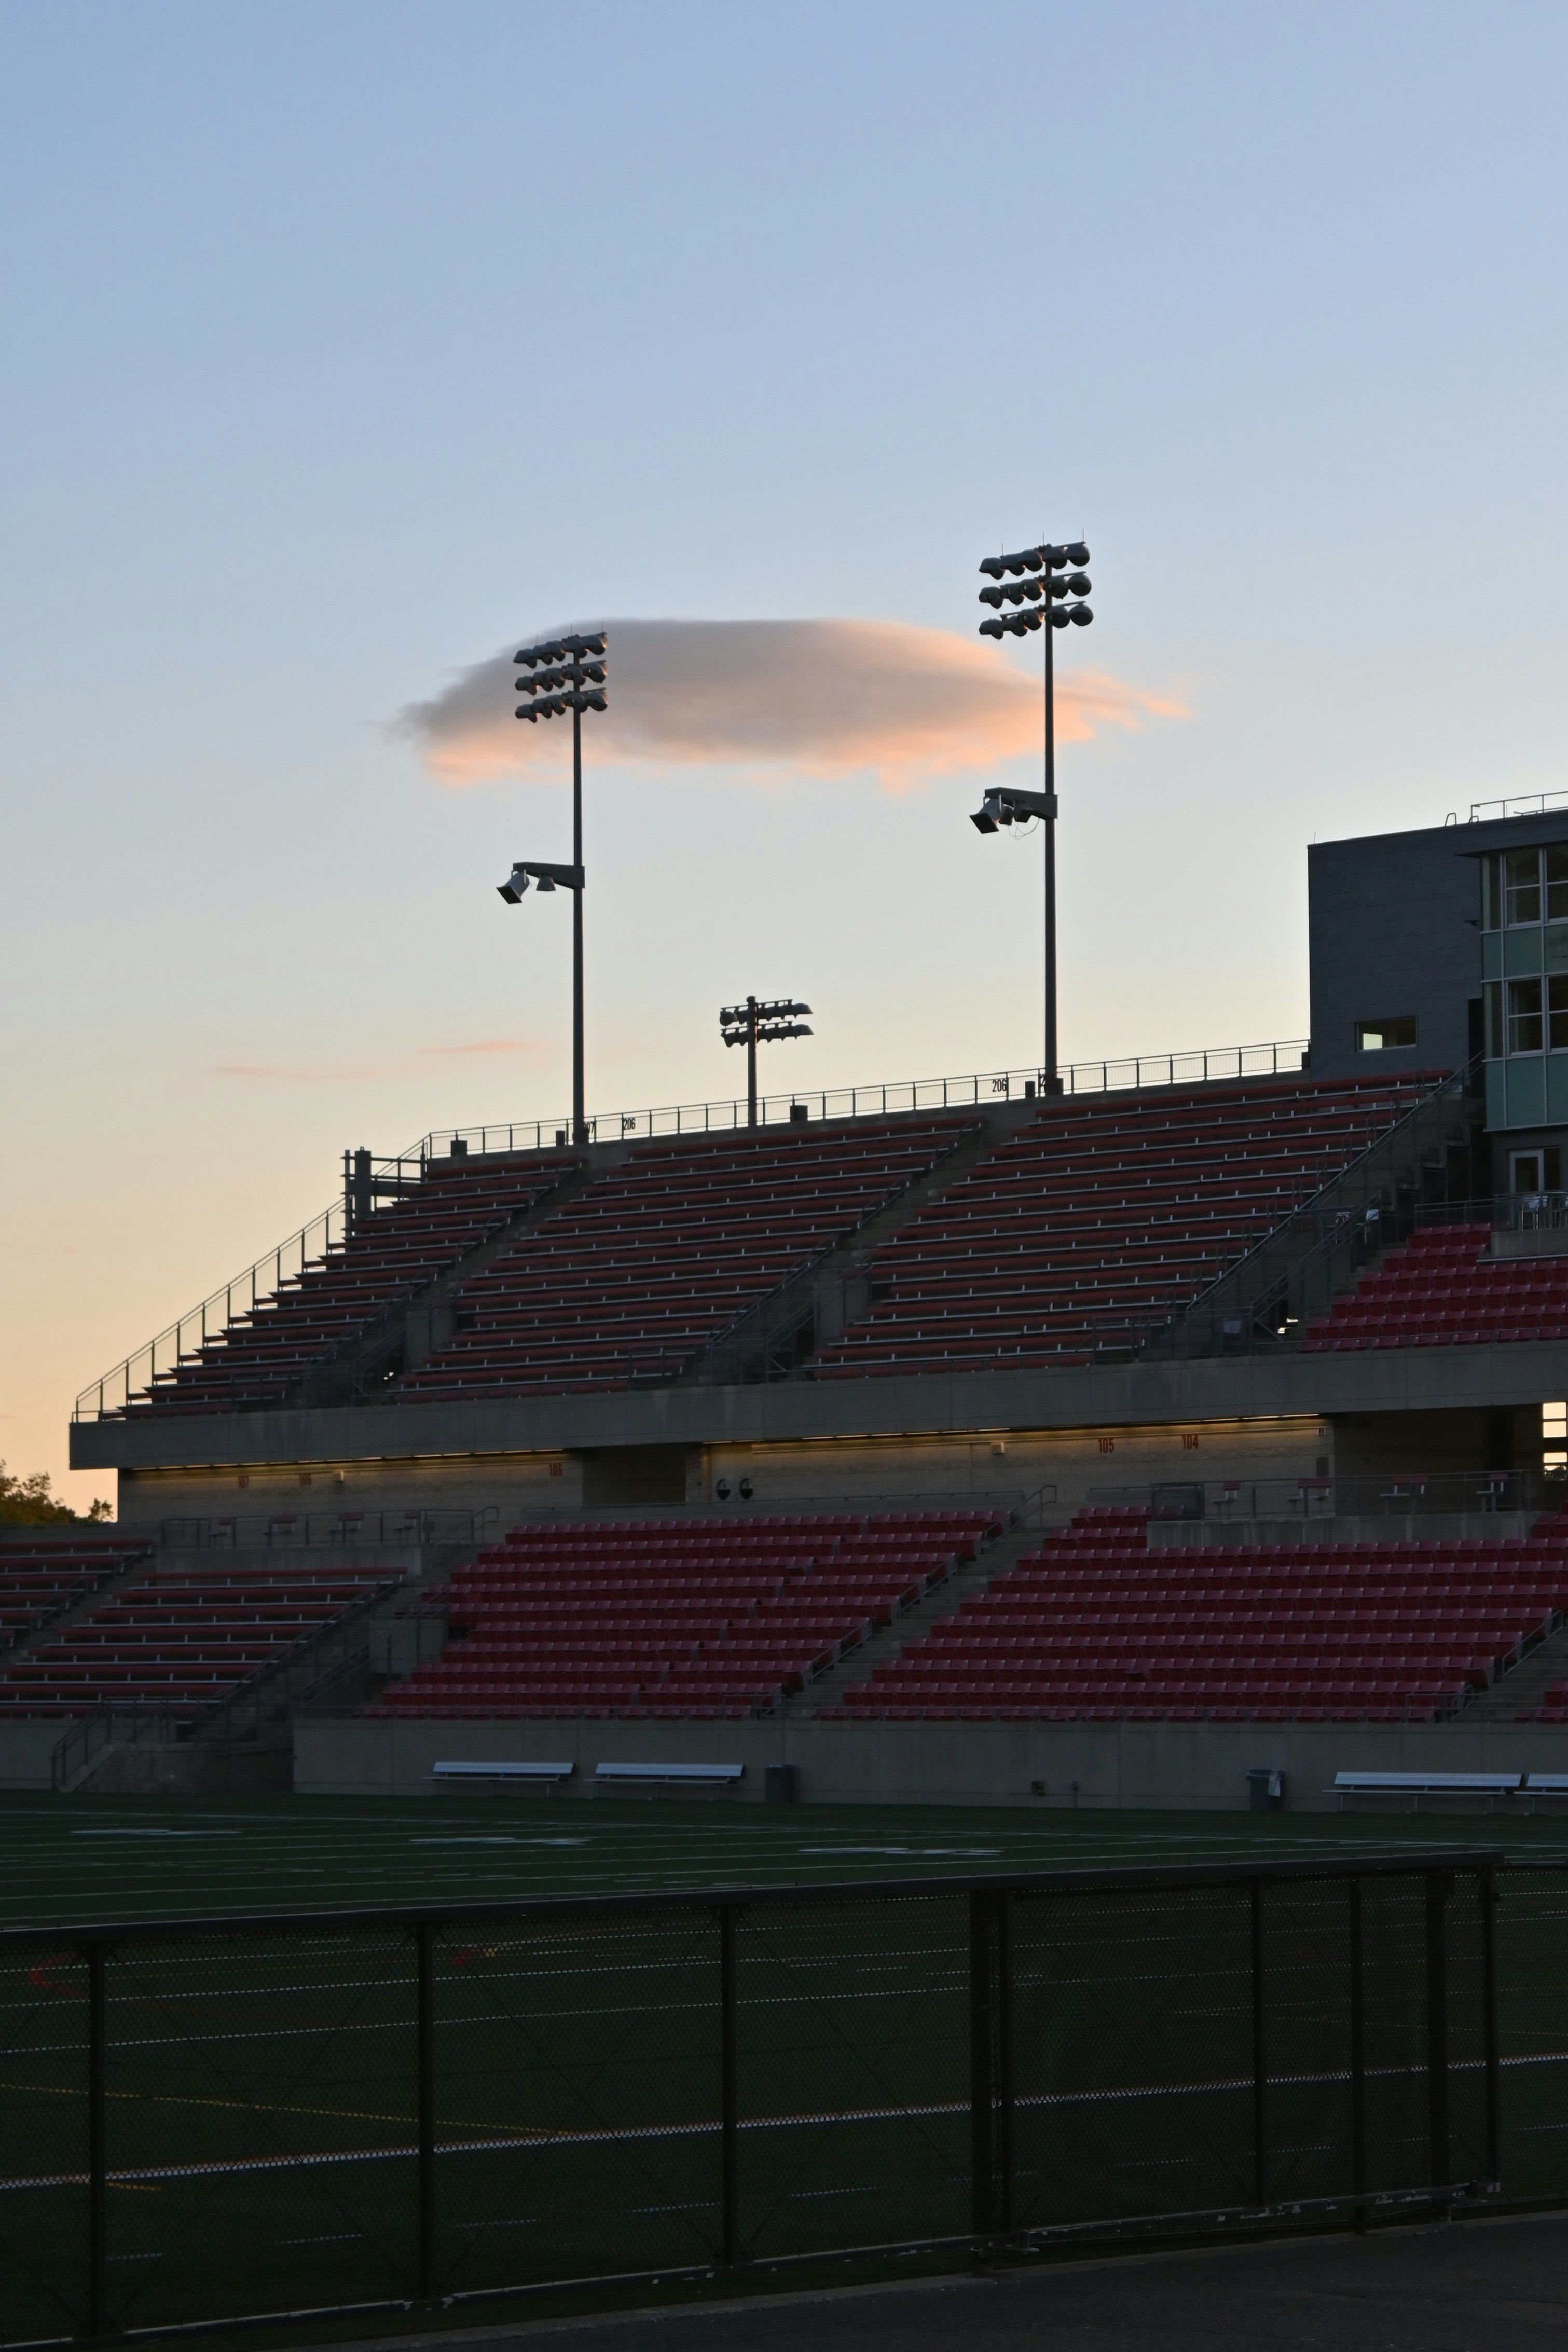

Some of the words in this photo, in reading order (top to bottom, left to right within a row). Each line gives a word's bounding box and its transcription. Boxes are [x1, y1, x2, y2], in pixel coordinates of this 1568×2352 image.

[992, 1079, 1007, 1092] 206
[623, 1118, 636, 1130] 206
[1098, 1438, 1115, 1453] 105
[1182, 1434, 1198, 1449] 104
[549, 1463, 563, 1477] 106
